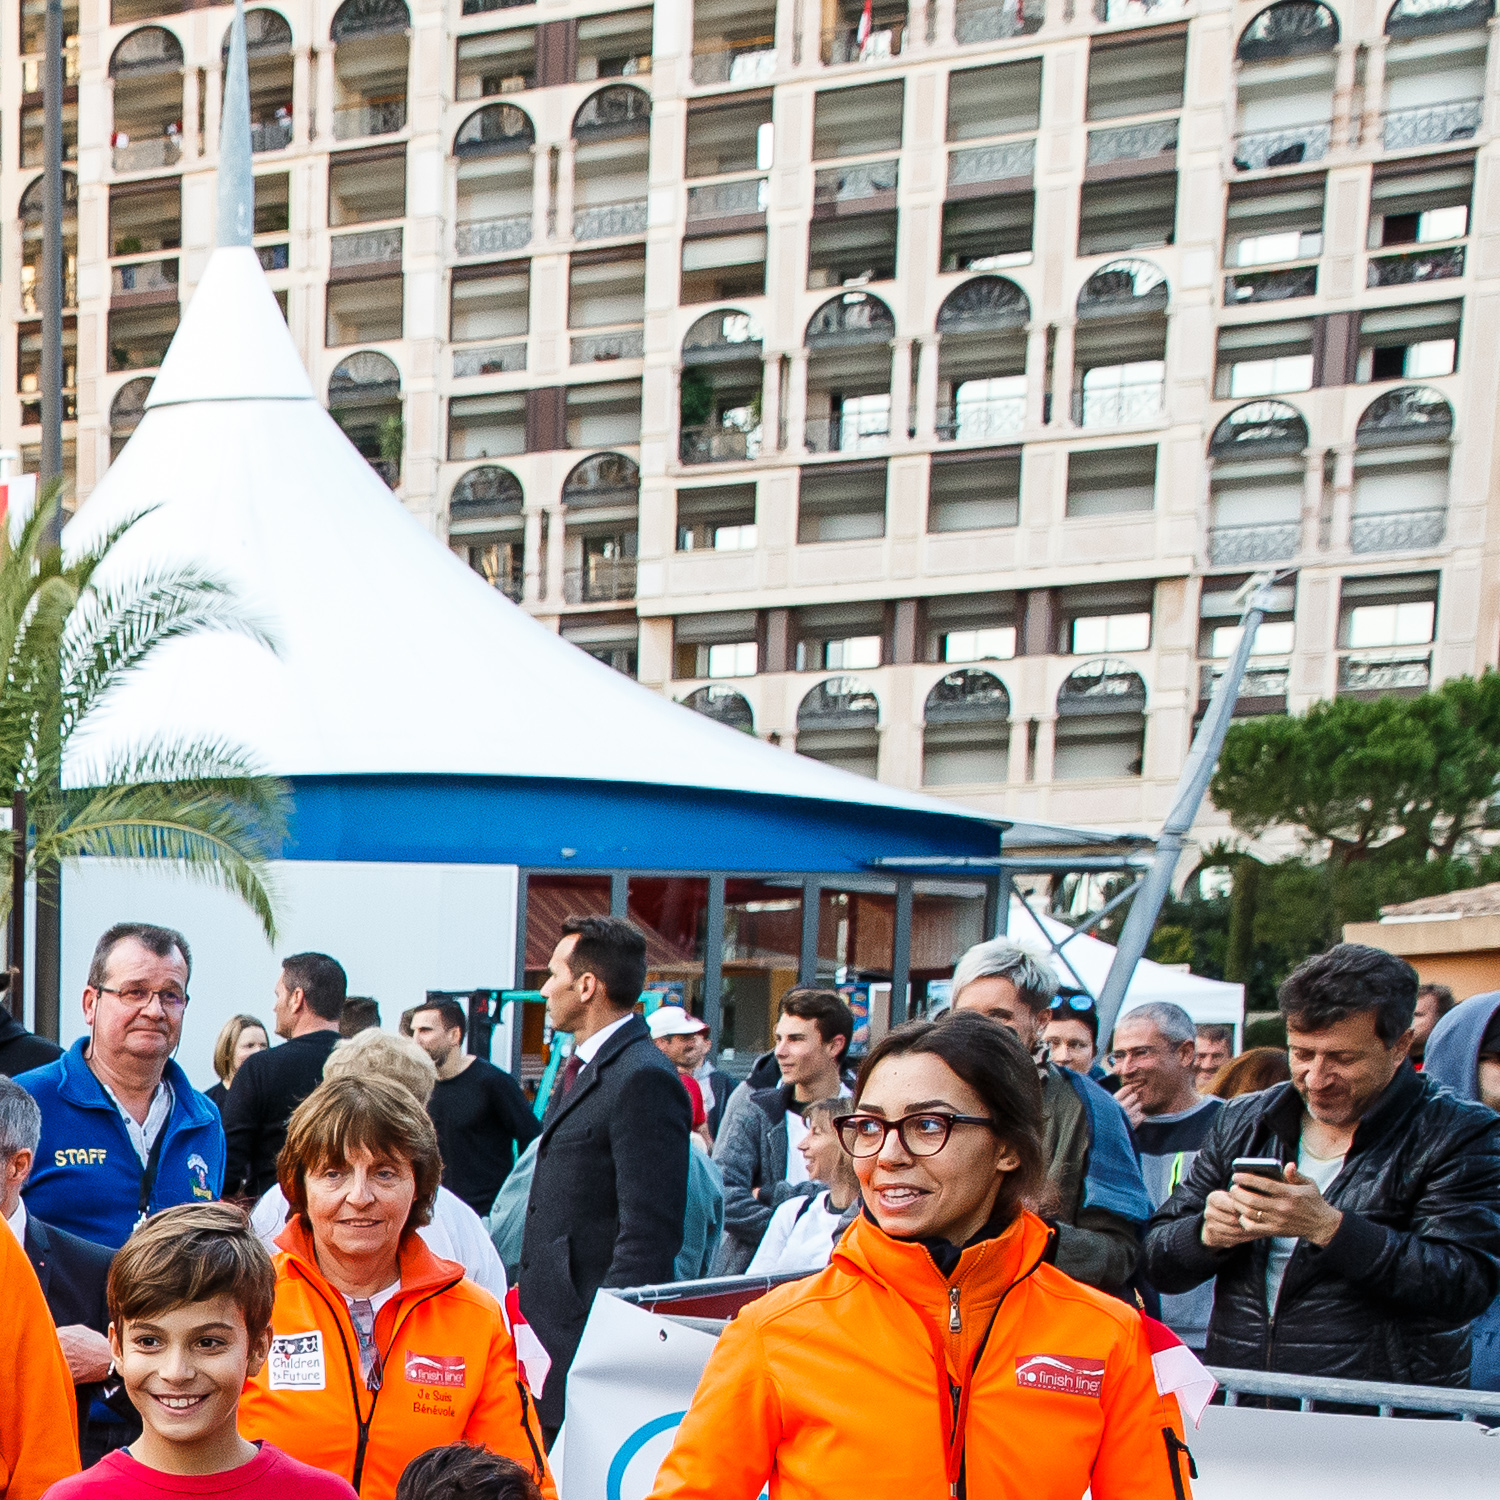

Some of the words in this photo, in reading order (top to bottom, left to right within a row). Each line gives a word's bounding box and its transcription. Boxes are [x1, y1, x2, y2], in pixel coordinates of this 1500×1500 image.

[55, 1148, 107, 1167] STAFF
[272, 1357, 320, 1369] Children
[283, 1369, 320, 1381] Future
[1018, 1370, 1037, 1382] no
[1039, 1370, 1073, 1388] finish
[417, 1388, 430, 1400] Je
[432, 1390, 452, 1402] Suis
[413, 1401, 455, 1417] Bénévole
